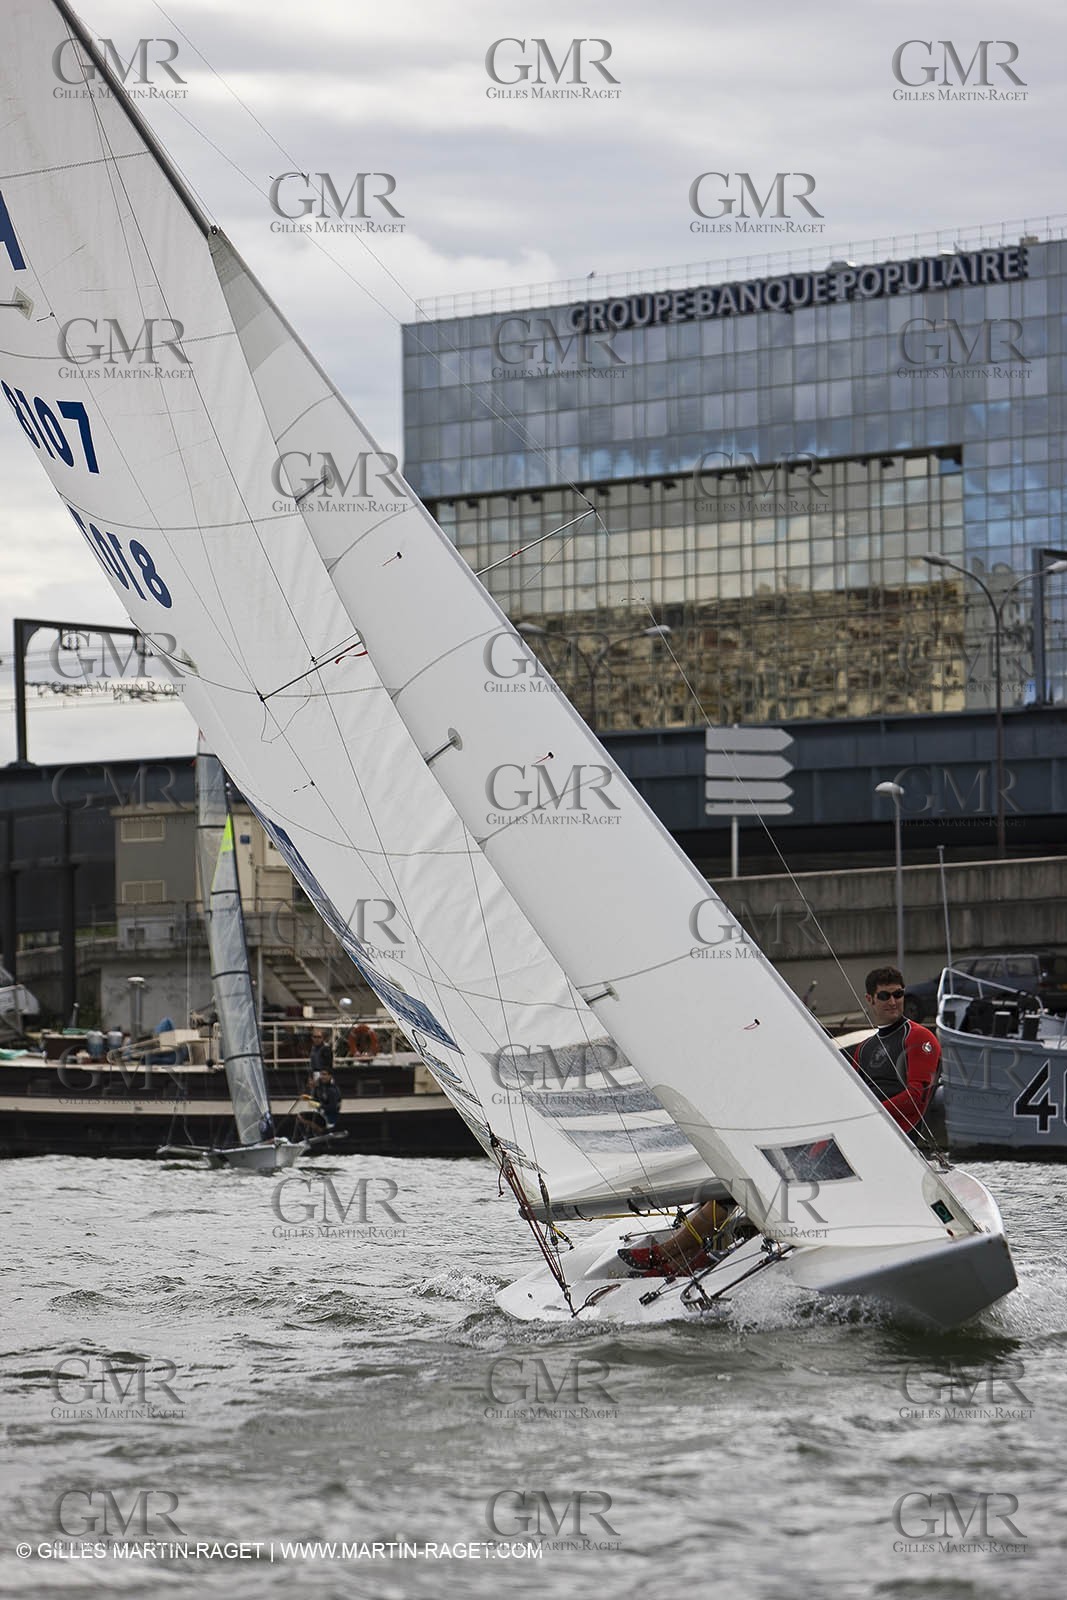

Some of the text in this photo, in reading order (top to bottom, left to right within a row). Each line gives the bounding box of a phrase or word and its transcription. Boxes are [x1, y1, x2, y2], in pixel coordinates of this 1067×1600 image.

[568, 249, 1019, 332] GROUPE BANQUE POPULAIRE
[0, 378, 100, 475] 8107
[1013, 1058, 1067, 1134] 4
